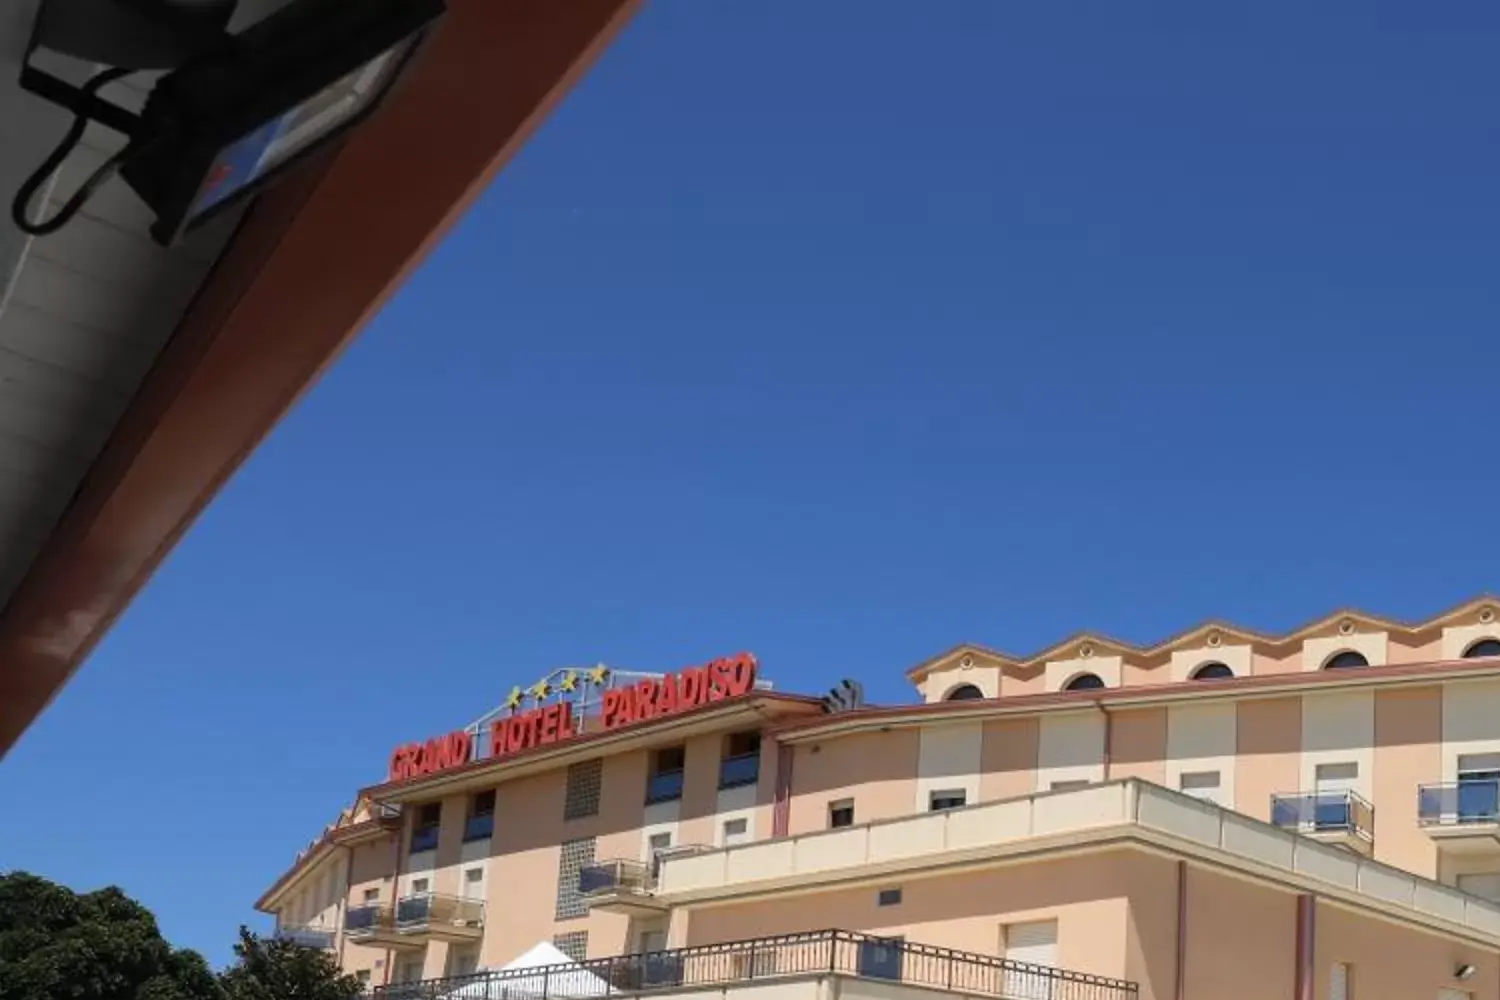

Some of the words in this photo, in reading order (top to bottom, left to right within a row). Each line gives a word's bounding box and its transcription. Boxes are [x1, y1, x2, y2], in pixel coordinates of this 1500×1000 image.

[389, 732, 472, 780] GRAND
[491, 702, 573, 757] HOTEL
[603, 652, 757, 728] PARADISO
